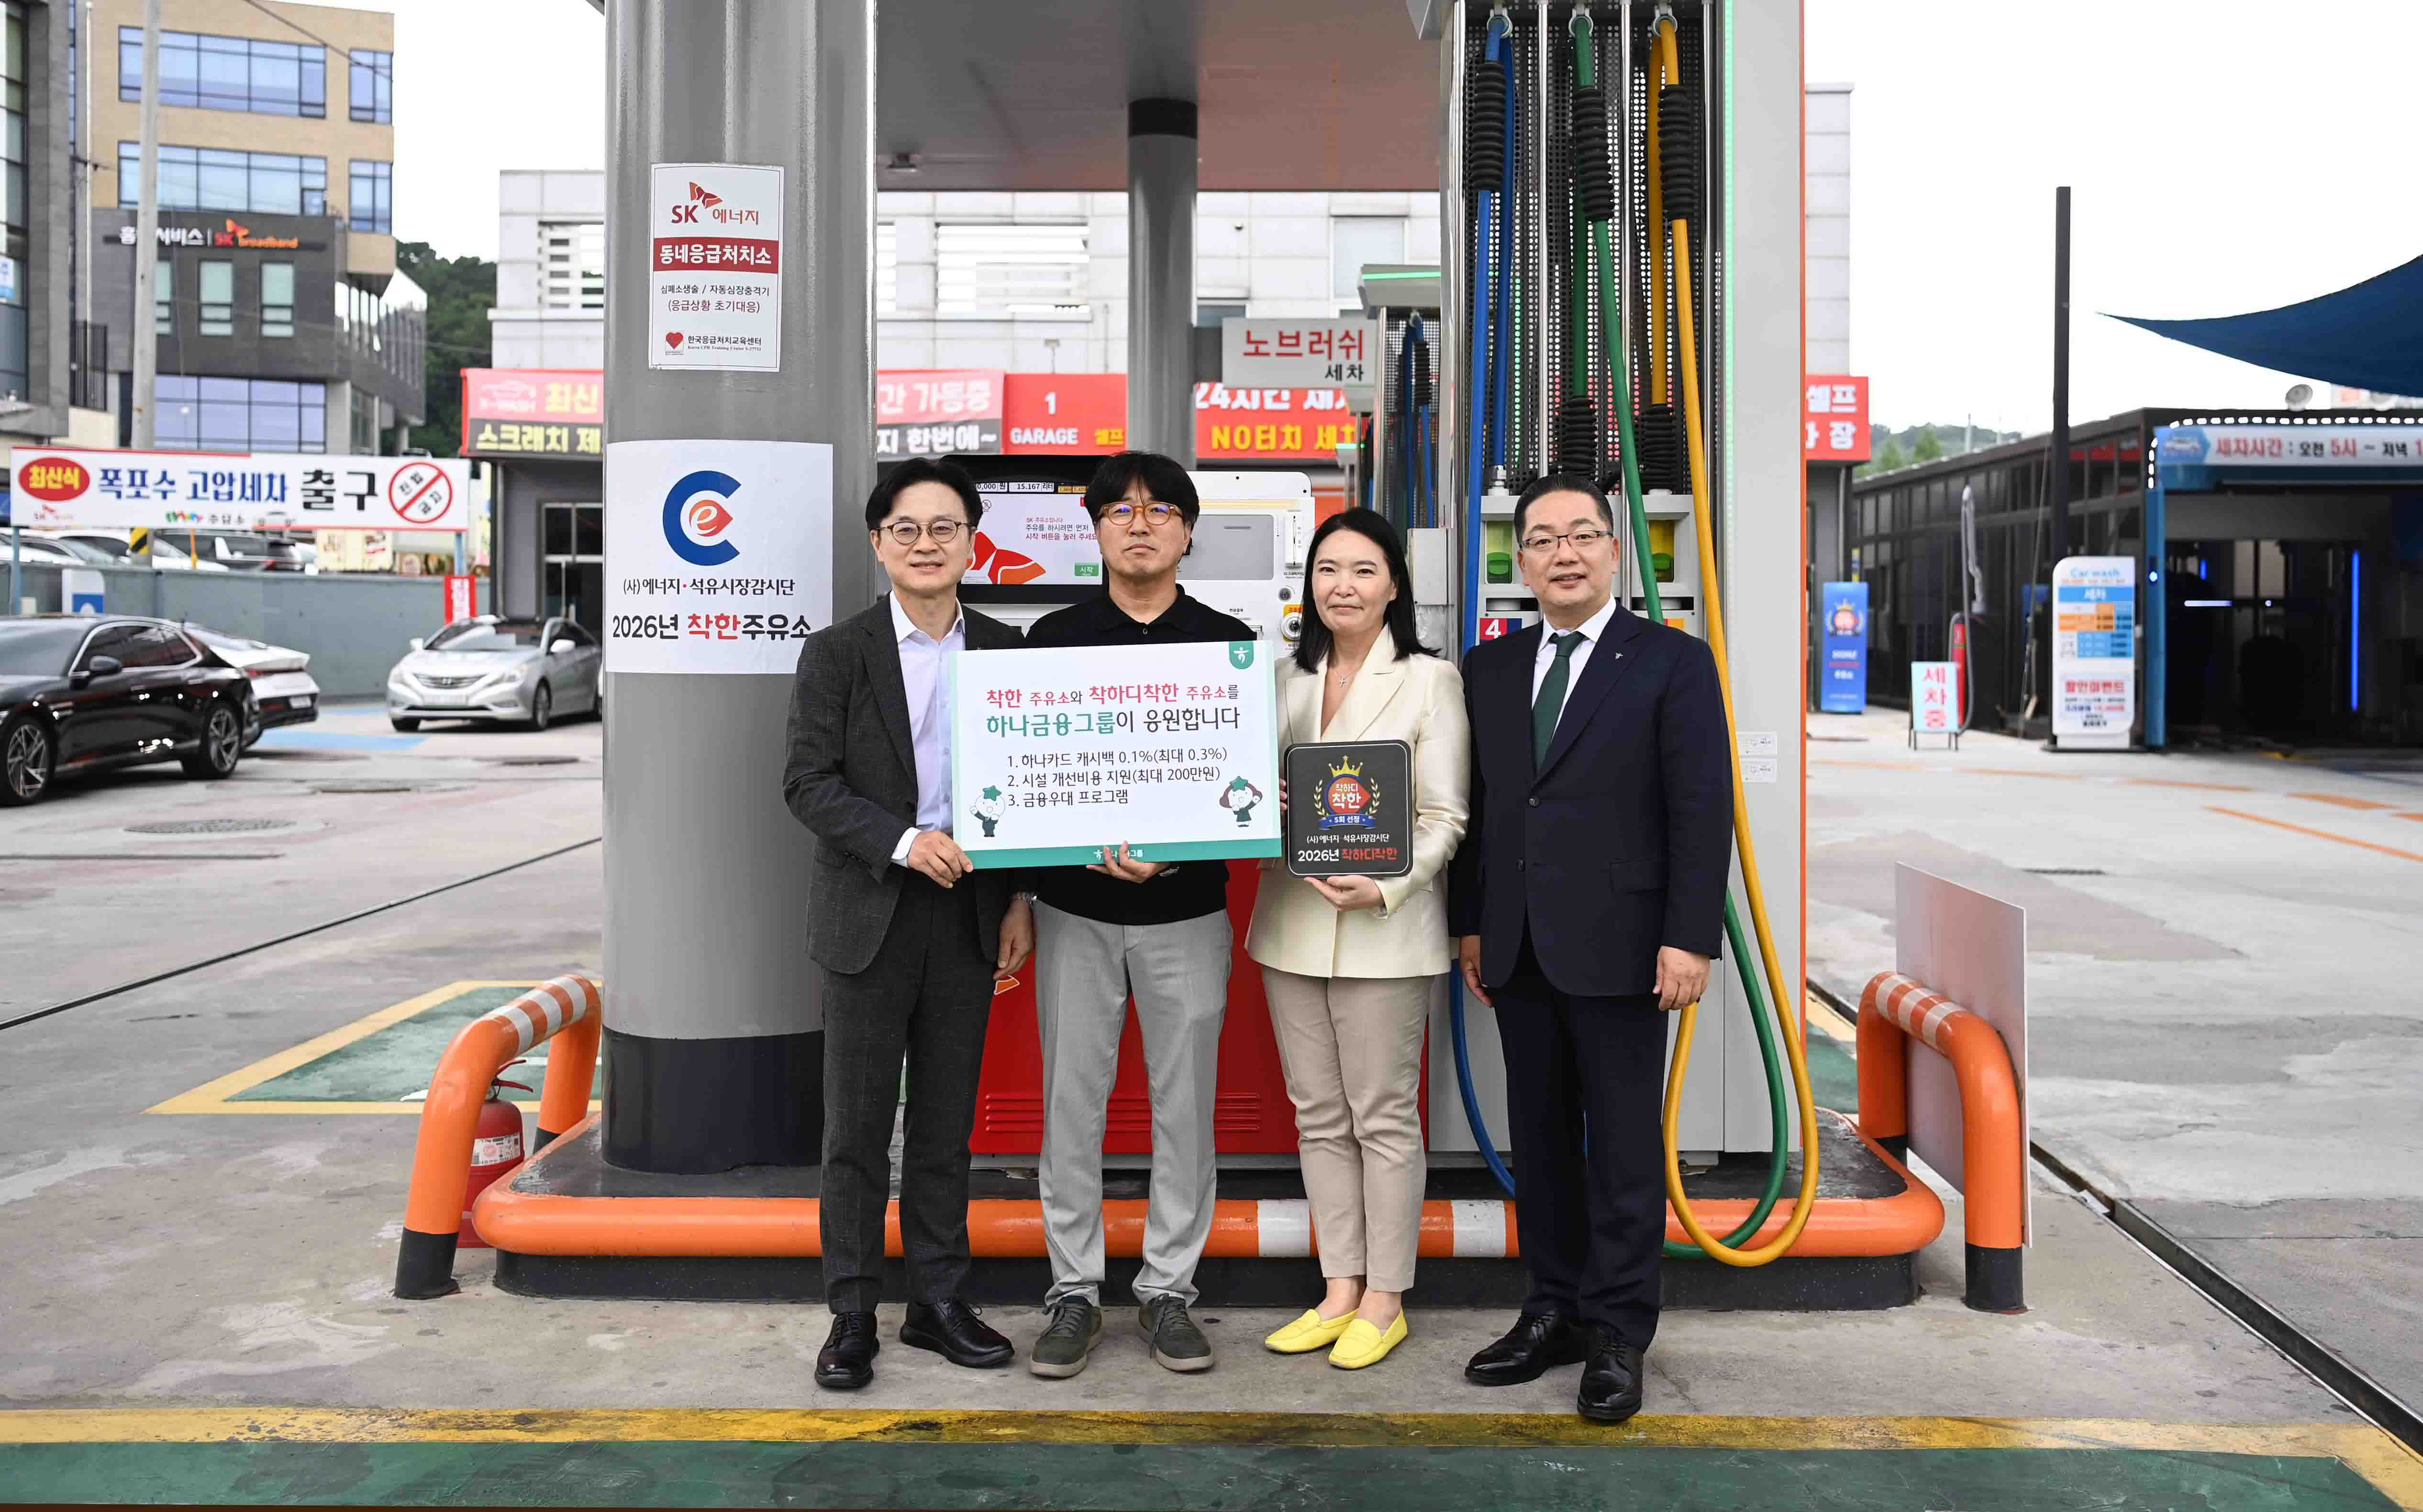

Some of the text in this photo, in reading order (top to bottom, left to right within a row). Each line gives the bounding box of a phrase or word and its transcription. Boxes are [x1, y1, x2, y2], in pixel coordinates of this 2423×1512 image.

[671, 205, 758, 225] SK 에너지
[120, 227, 205, 246] 홈서비스
[214, 233, 299, 249] SK broadband
[660, 245, 772, 265] 동네응급처치소
[661, 285, 699, 294] 심폐소생술
[710, 285, 769, 296] 자동심장충격기
[668, 300, 760, 313] (응급상황 초기대응)
[688, 335, 762, 345] 한국응급처치교육센터
[1243, 329, 1363, 360] 노브러쉬
[1325, 364, 1364, 381] 세차
[546, 383, 598, 413] 최신
[913, 379, 990, 413] 가동중
[1045, 392, 1056, 414] 1
[477, 423, 569, 453] 스크레치
[1011, 428, 1078, 445] GARAGE
[1212, 424, 1302, 451] NO터치
[2216, 437, 2282, 458] 세차시간
[2300, 441, 2325, 457] 오전
[2331, 438, 2357, 457] 5시
[2381, 442, 2408, 458] 저녁
[29, 465, 378, 511] 최신식 폭포수 고압세차 출구
[612, 613, 811, 641] 2026년 착한주유소
[1485, 619, 1501, 638] 4
[987, 683, 1239, 708] 착한 주유소와 착하디착한 주유소를
[987, 707, 1240, 738] 하나금융그룹이 응원합니다
[1008, 746, 1228, 768] 1. 하나카드 캐시백 0.1%(최대 0.3%)
[1008, 767, 1221, 788] 2. 시설 개선비용 지원(최대 200만원)
[1335, 783, 1358, 792] 착하디
[1008, 789, 1129, 809] 3. 금융우대 프로그램
[1332, 792, 1362, 809] 착한
[1344, 834, 1389, 843] 석유시장감시단
[1298, 848, 1397, 862] 2026년 착하디착한
